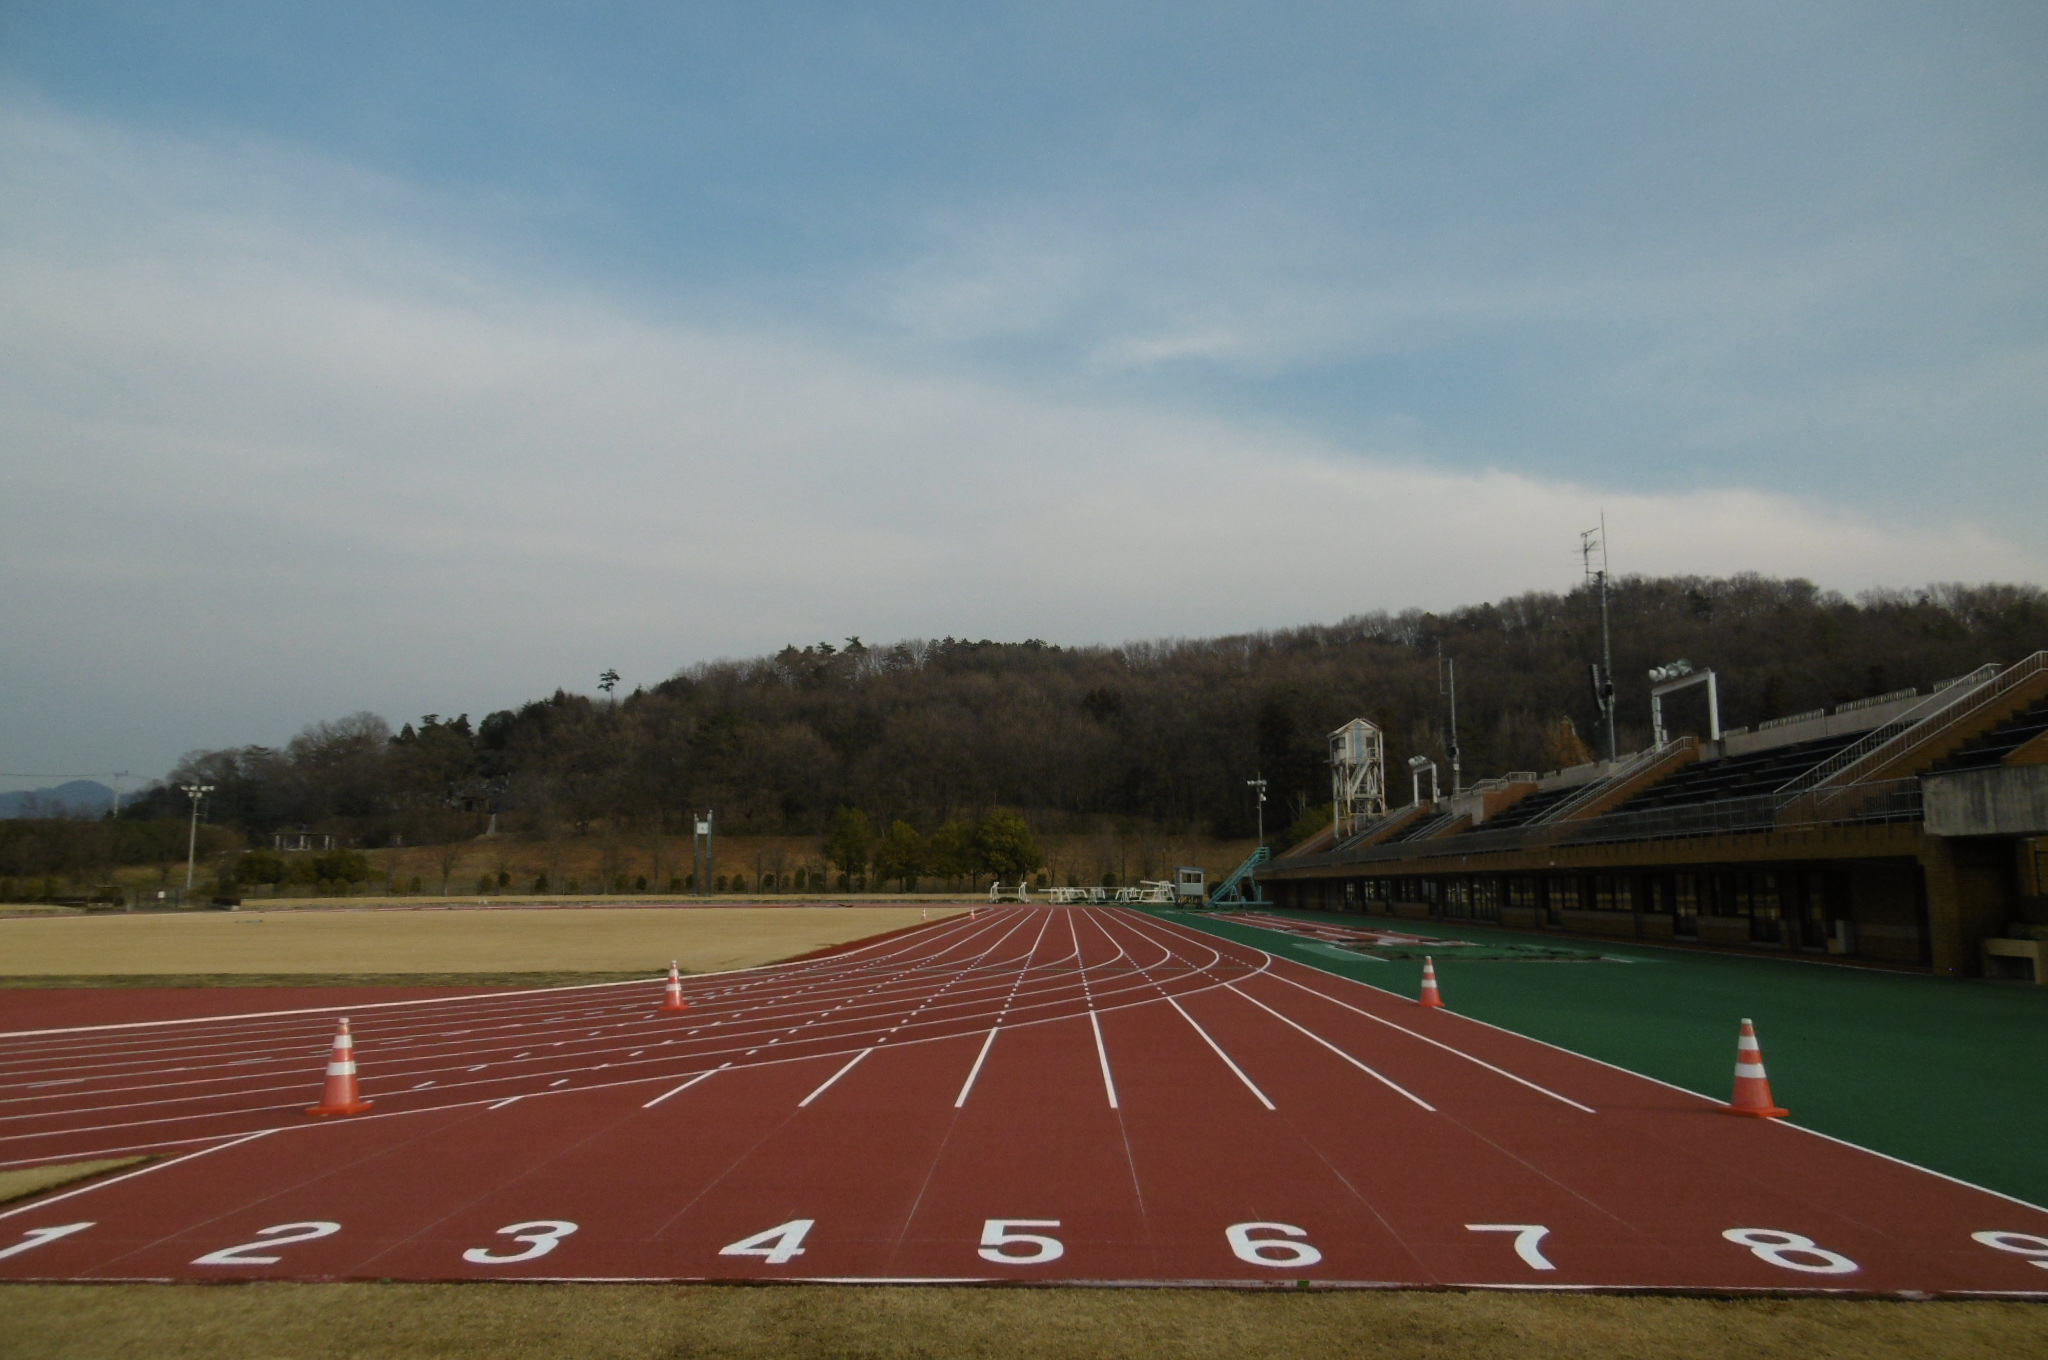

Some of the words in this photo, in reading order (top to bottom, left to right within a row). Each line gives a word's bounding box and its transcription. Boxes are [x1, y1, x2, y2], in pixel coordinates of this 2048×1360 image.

[0, 1222, 97, 1260] 1
[190, 1221, 342, 1265] 2
[462, 1220, 579, 1264] 3
[718, 1219, 815, 1265] 4
[977, 1219, 1064, 1265] 5
[1225, 1222, 1322, 1268] 6
[1464, 1224, 1556, 1271] 7
[1721, 1227, 1859, 1275] 8
